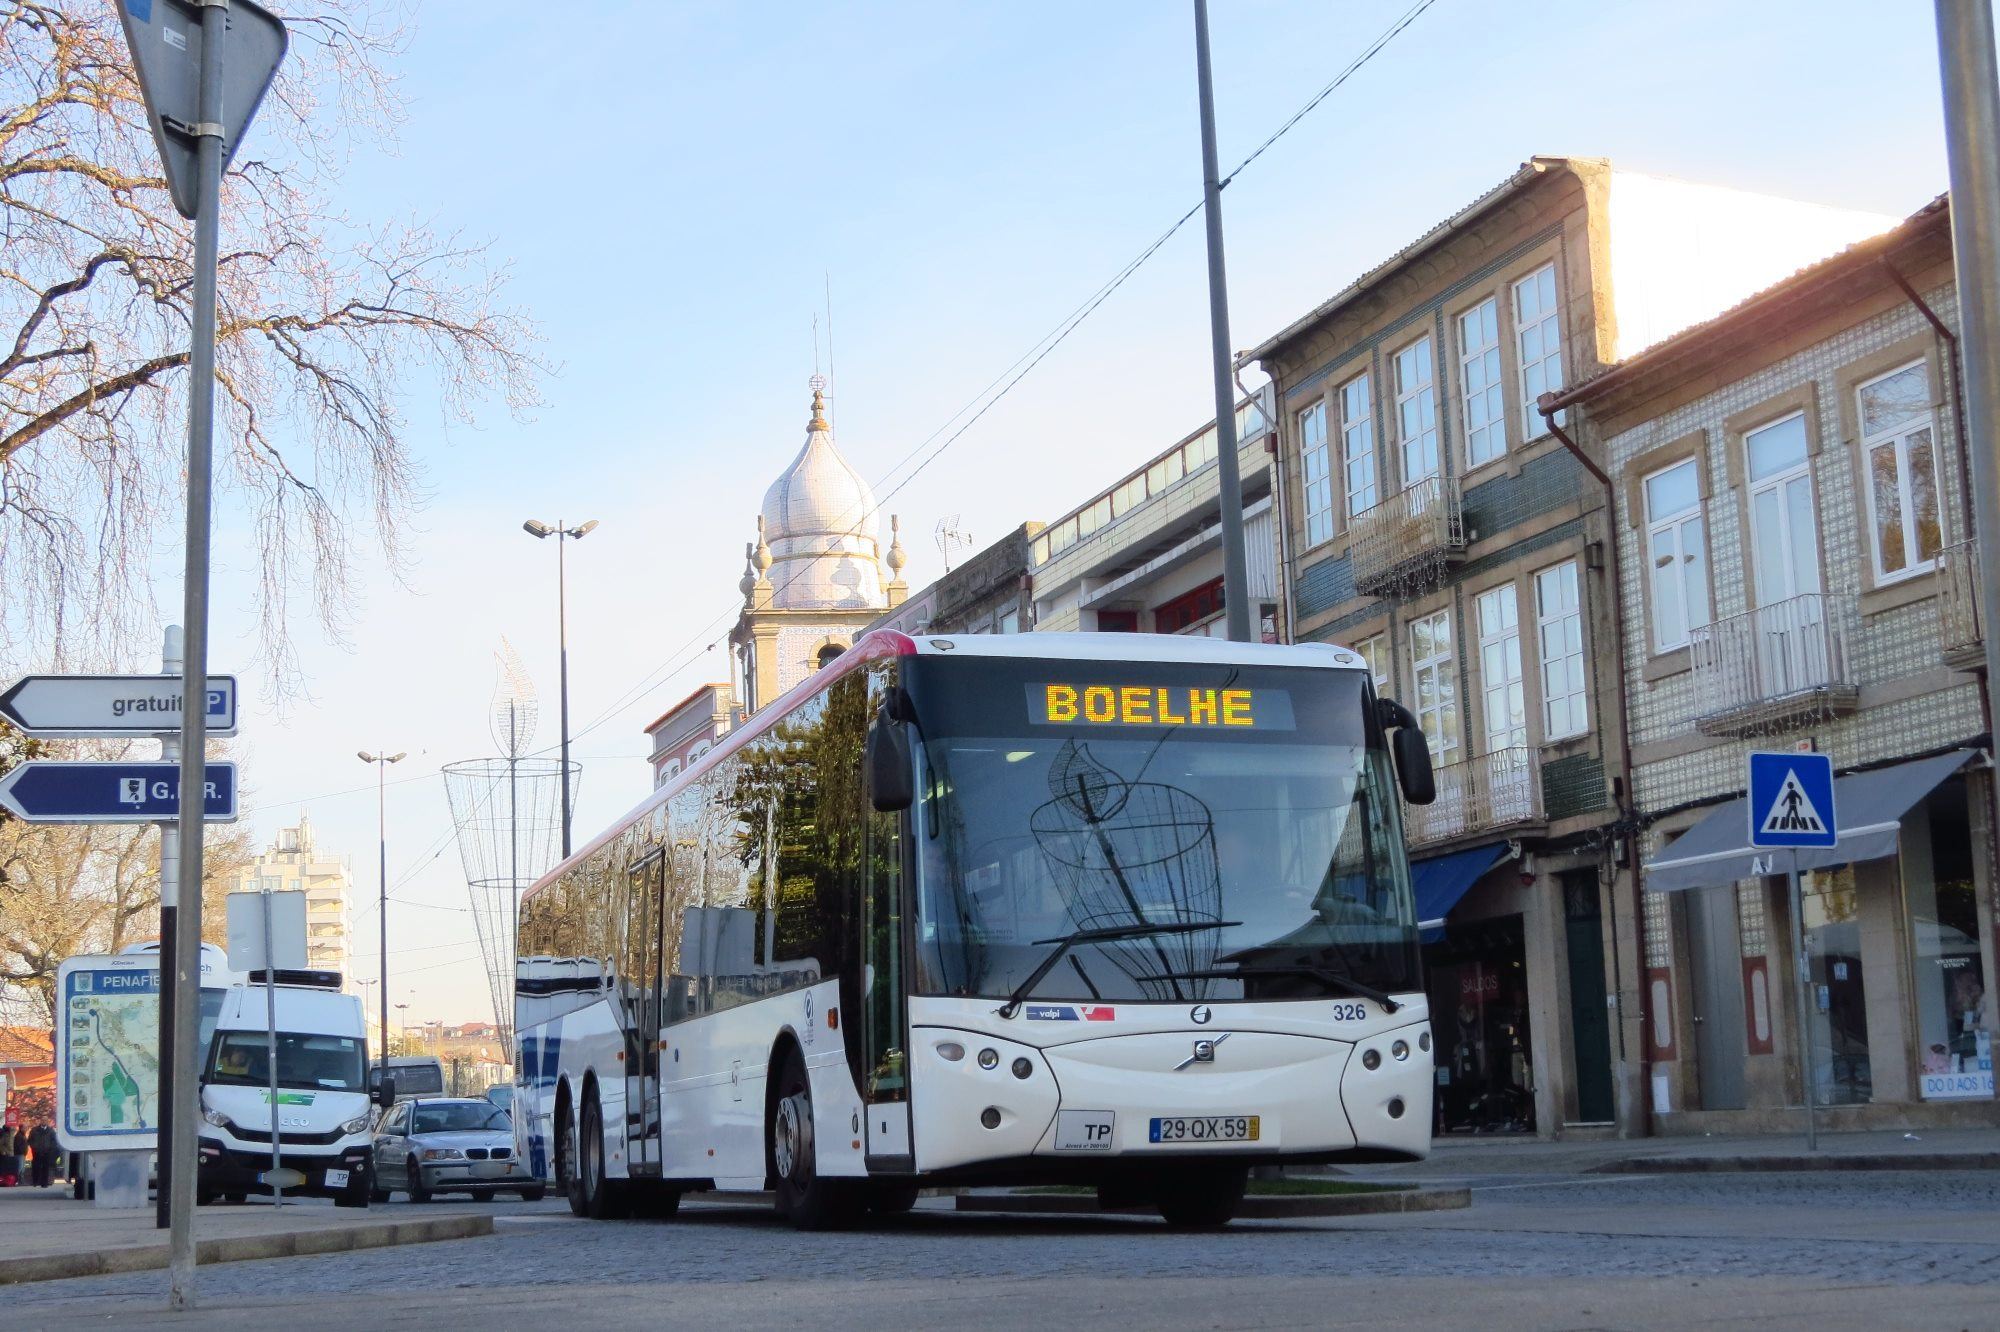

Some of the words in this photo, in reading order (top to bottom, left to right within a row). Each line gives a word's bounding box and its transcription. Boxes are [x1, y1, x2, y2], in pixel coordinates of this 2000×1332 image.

[112, 694, 182, 717] gratuit
[1047, 685, 1253, 725] BOELHE
[103, 974, 160, 988] PENAFIE
[1462, 975, 1498, 993] SALDOS
[1039, 1008, 1060, 1019] valpi
[1333, 1004, 1366, 1021] 326
[1928, 1078, 1945, 1092] DO
[1957, 1077, 1978, 1091] AOS
[1085, 1124, 1111, 1140] TP
[336, 1172, 348, 1181] TP
